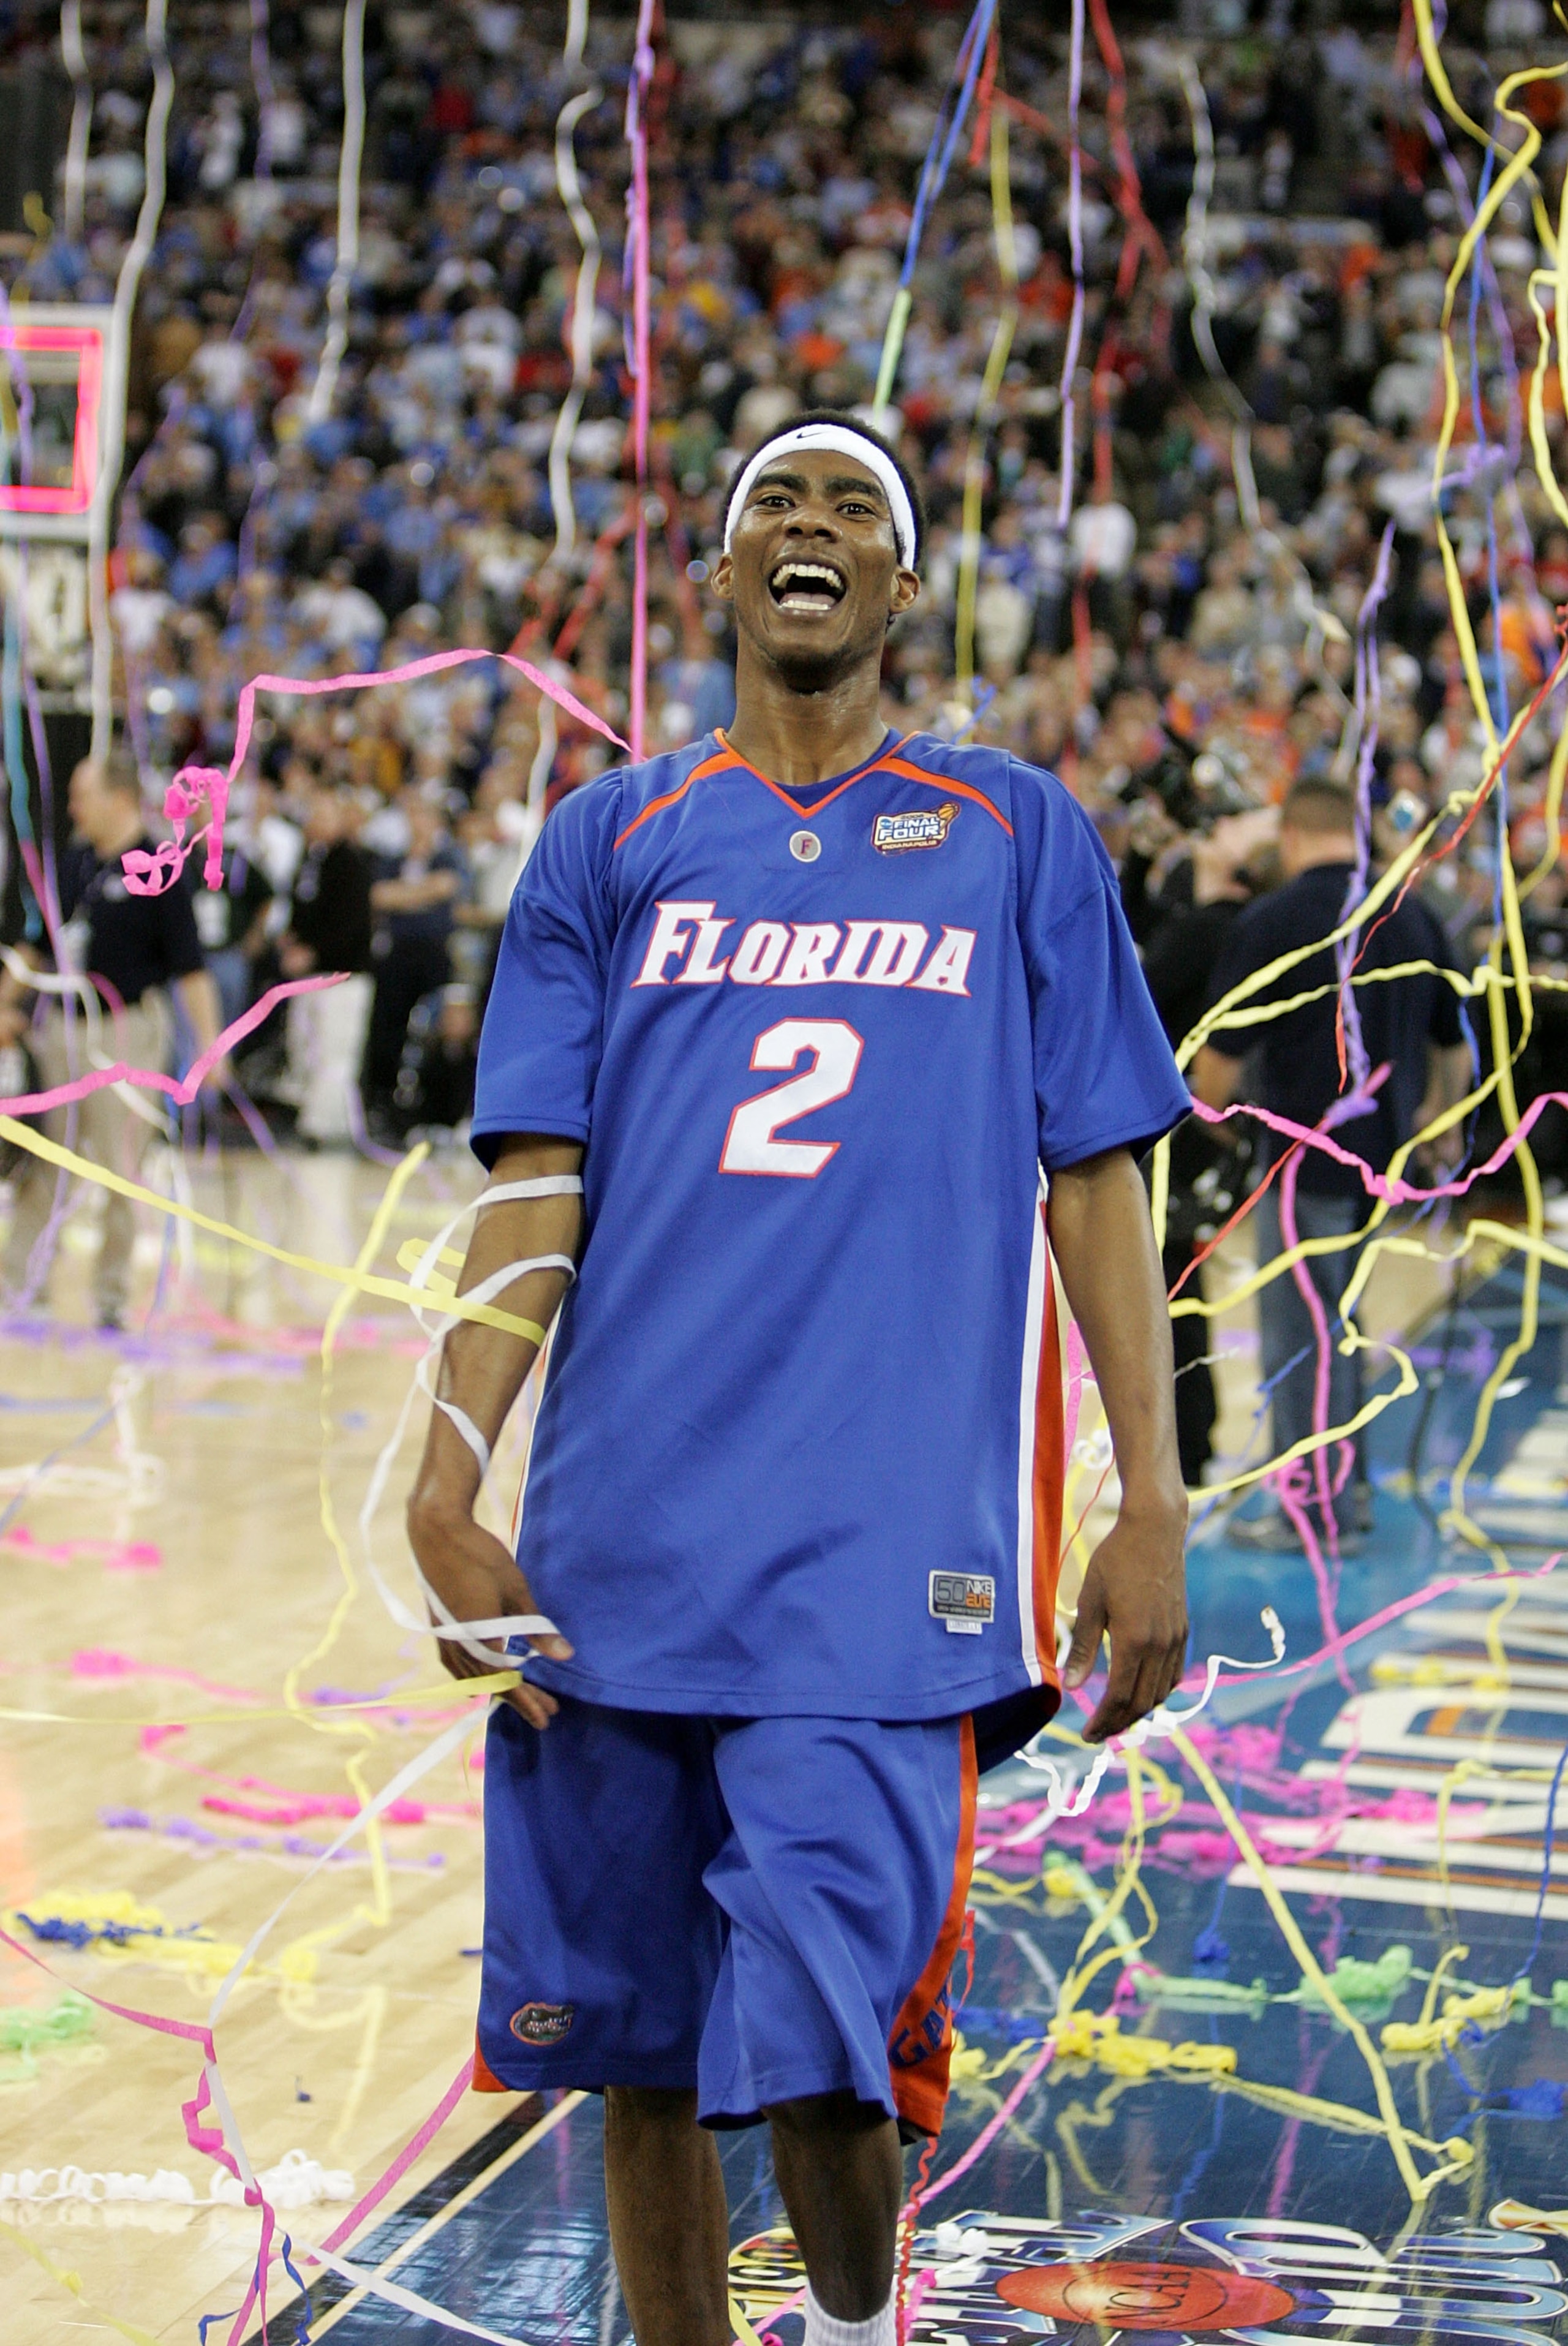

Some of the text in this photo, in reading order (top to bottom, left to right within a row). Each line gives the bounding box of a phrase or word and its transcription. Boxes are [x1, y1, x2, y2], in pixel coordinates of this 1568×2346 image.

[879, 825, 940, 840] FOUR
[894, 818, 940, 829] FINAL
[799, 838, 813, 856] F
[630, 900, 978, 998] FLORIDA
[718, 1017, 865, 1179] 2
[1102, 2270, 1193, 2325] NCAA
